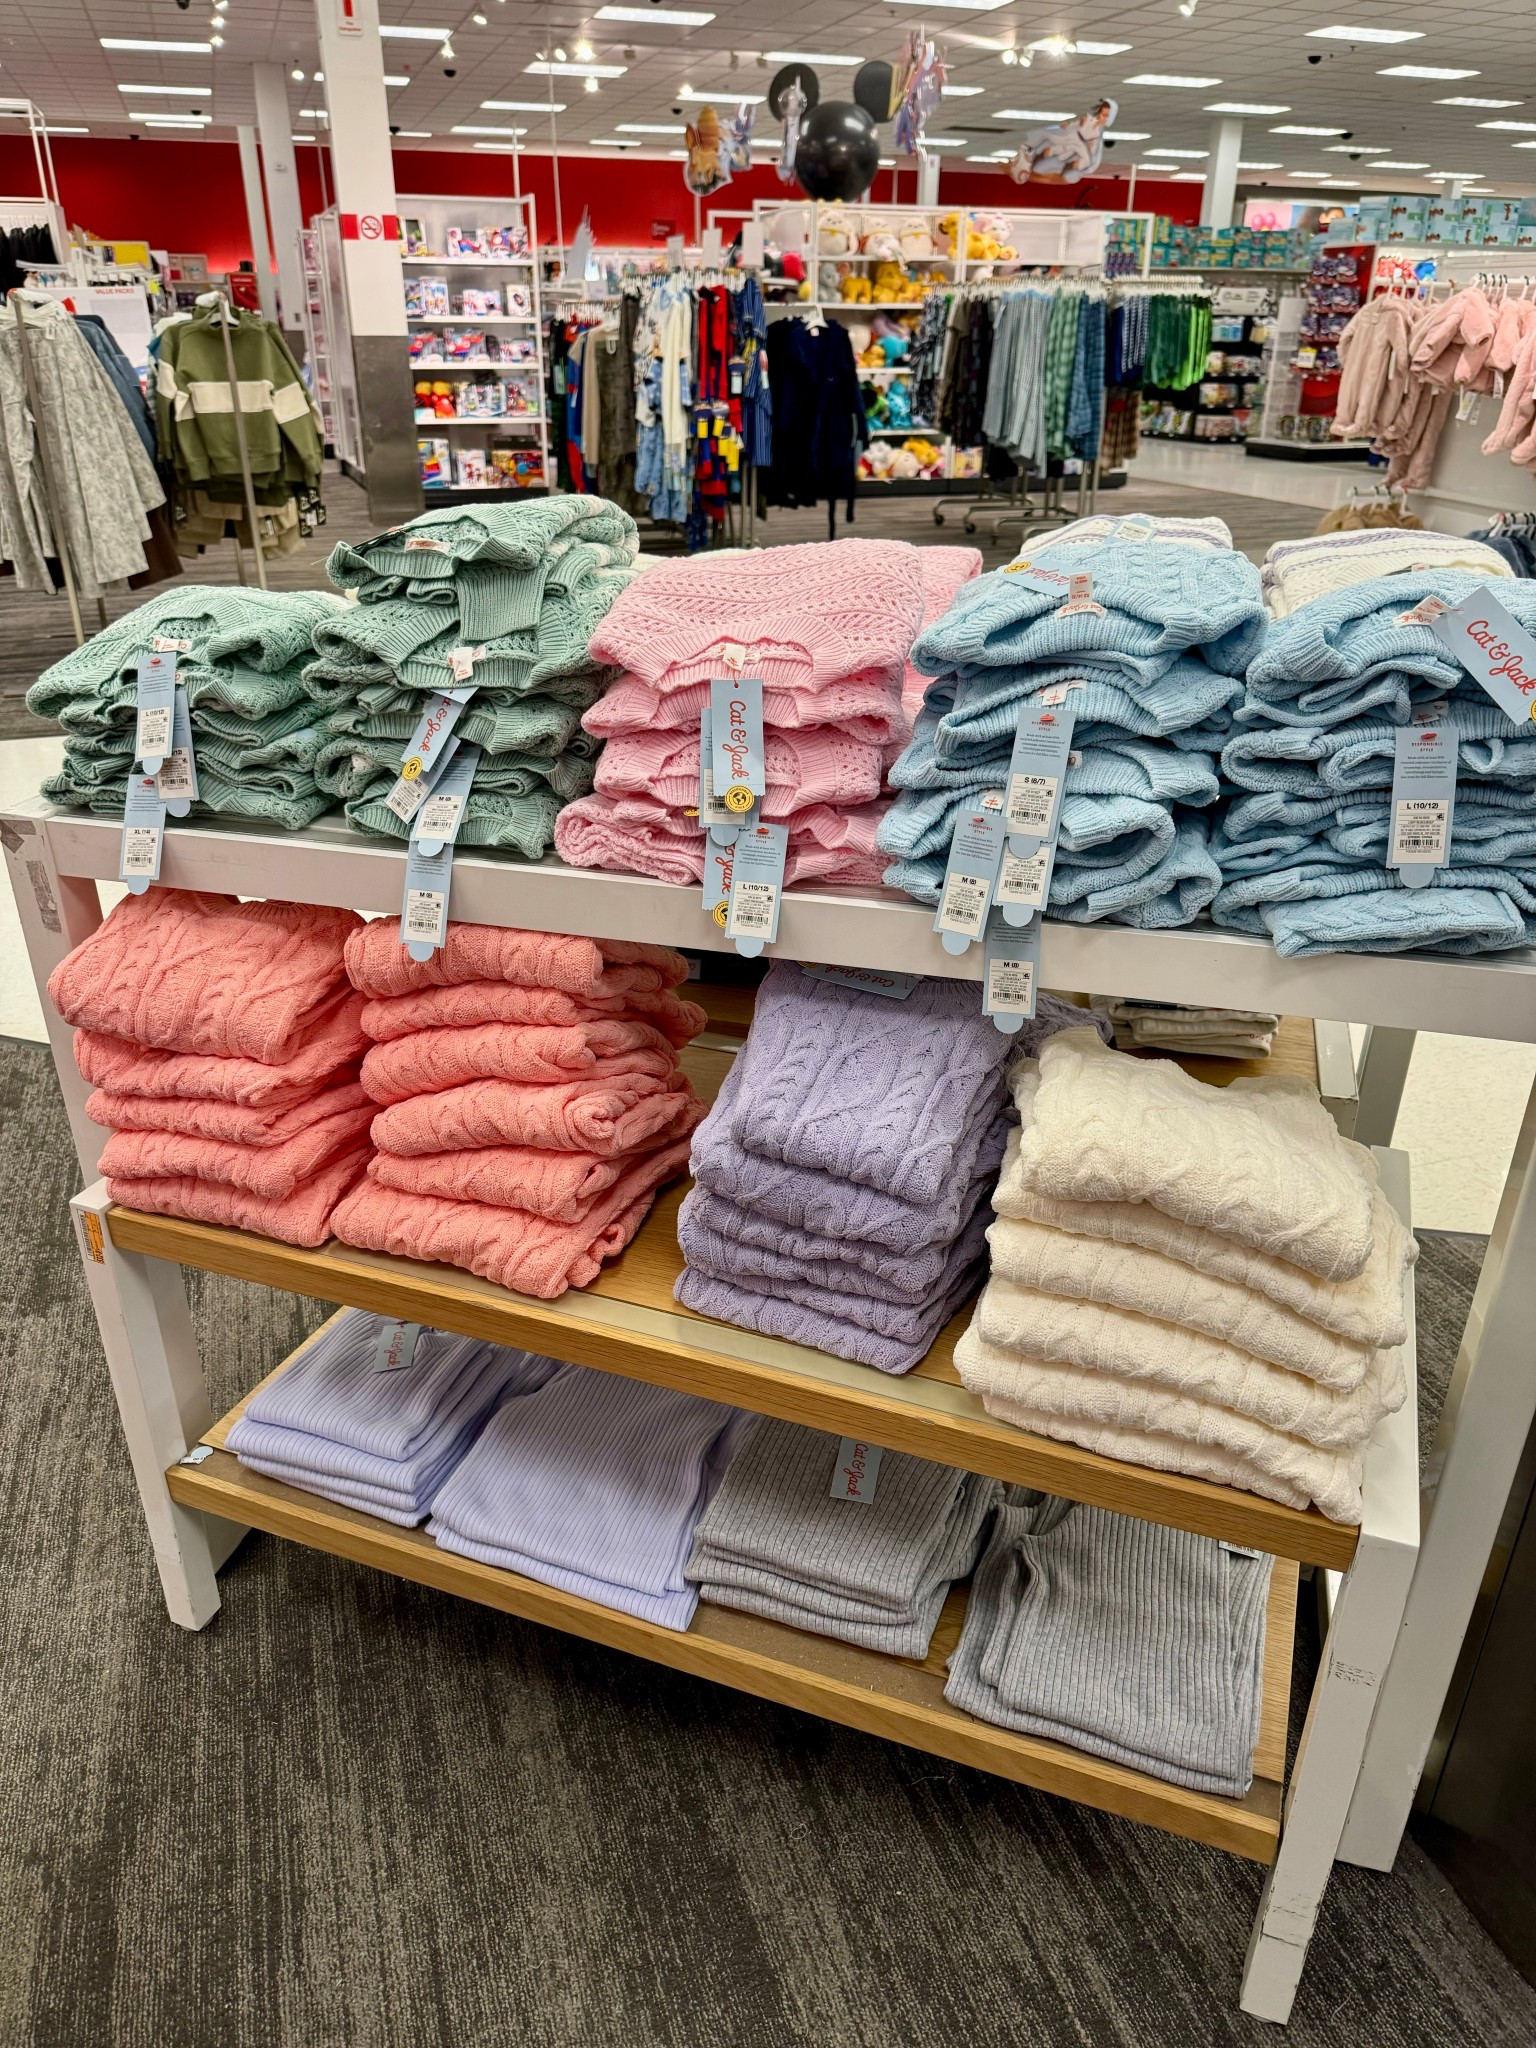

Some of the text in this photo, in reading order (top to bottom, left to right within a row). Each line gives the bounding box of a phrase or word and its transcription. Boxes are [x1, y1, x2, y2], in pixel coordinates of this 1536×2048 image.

[1466, 620, 1536, 696] Cat & Jack
[435, 707, 448, 723] &
[418, 718, 441, 753] Jack
[722, 700, 750, 780] Cat & Jack
[748, 884, 770, 892] (10/12)
[961, 876, 968, 884] M
[824, 963, 861, 979] Jack
[872, 975, 895, 988] Cat
[843, 1443, 869, 1496] Cat & Jack
